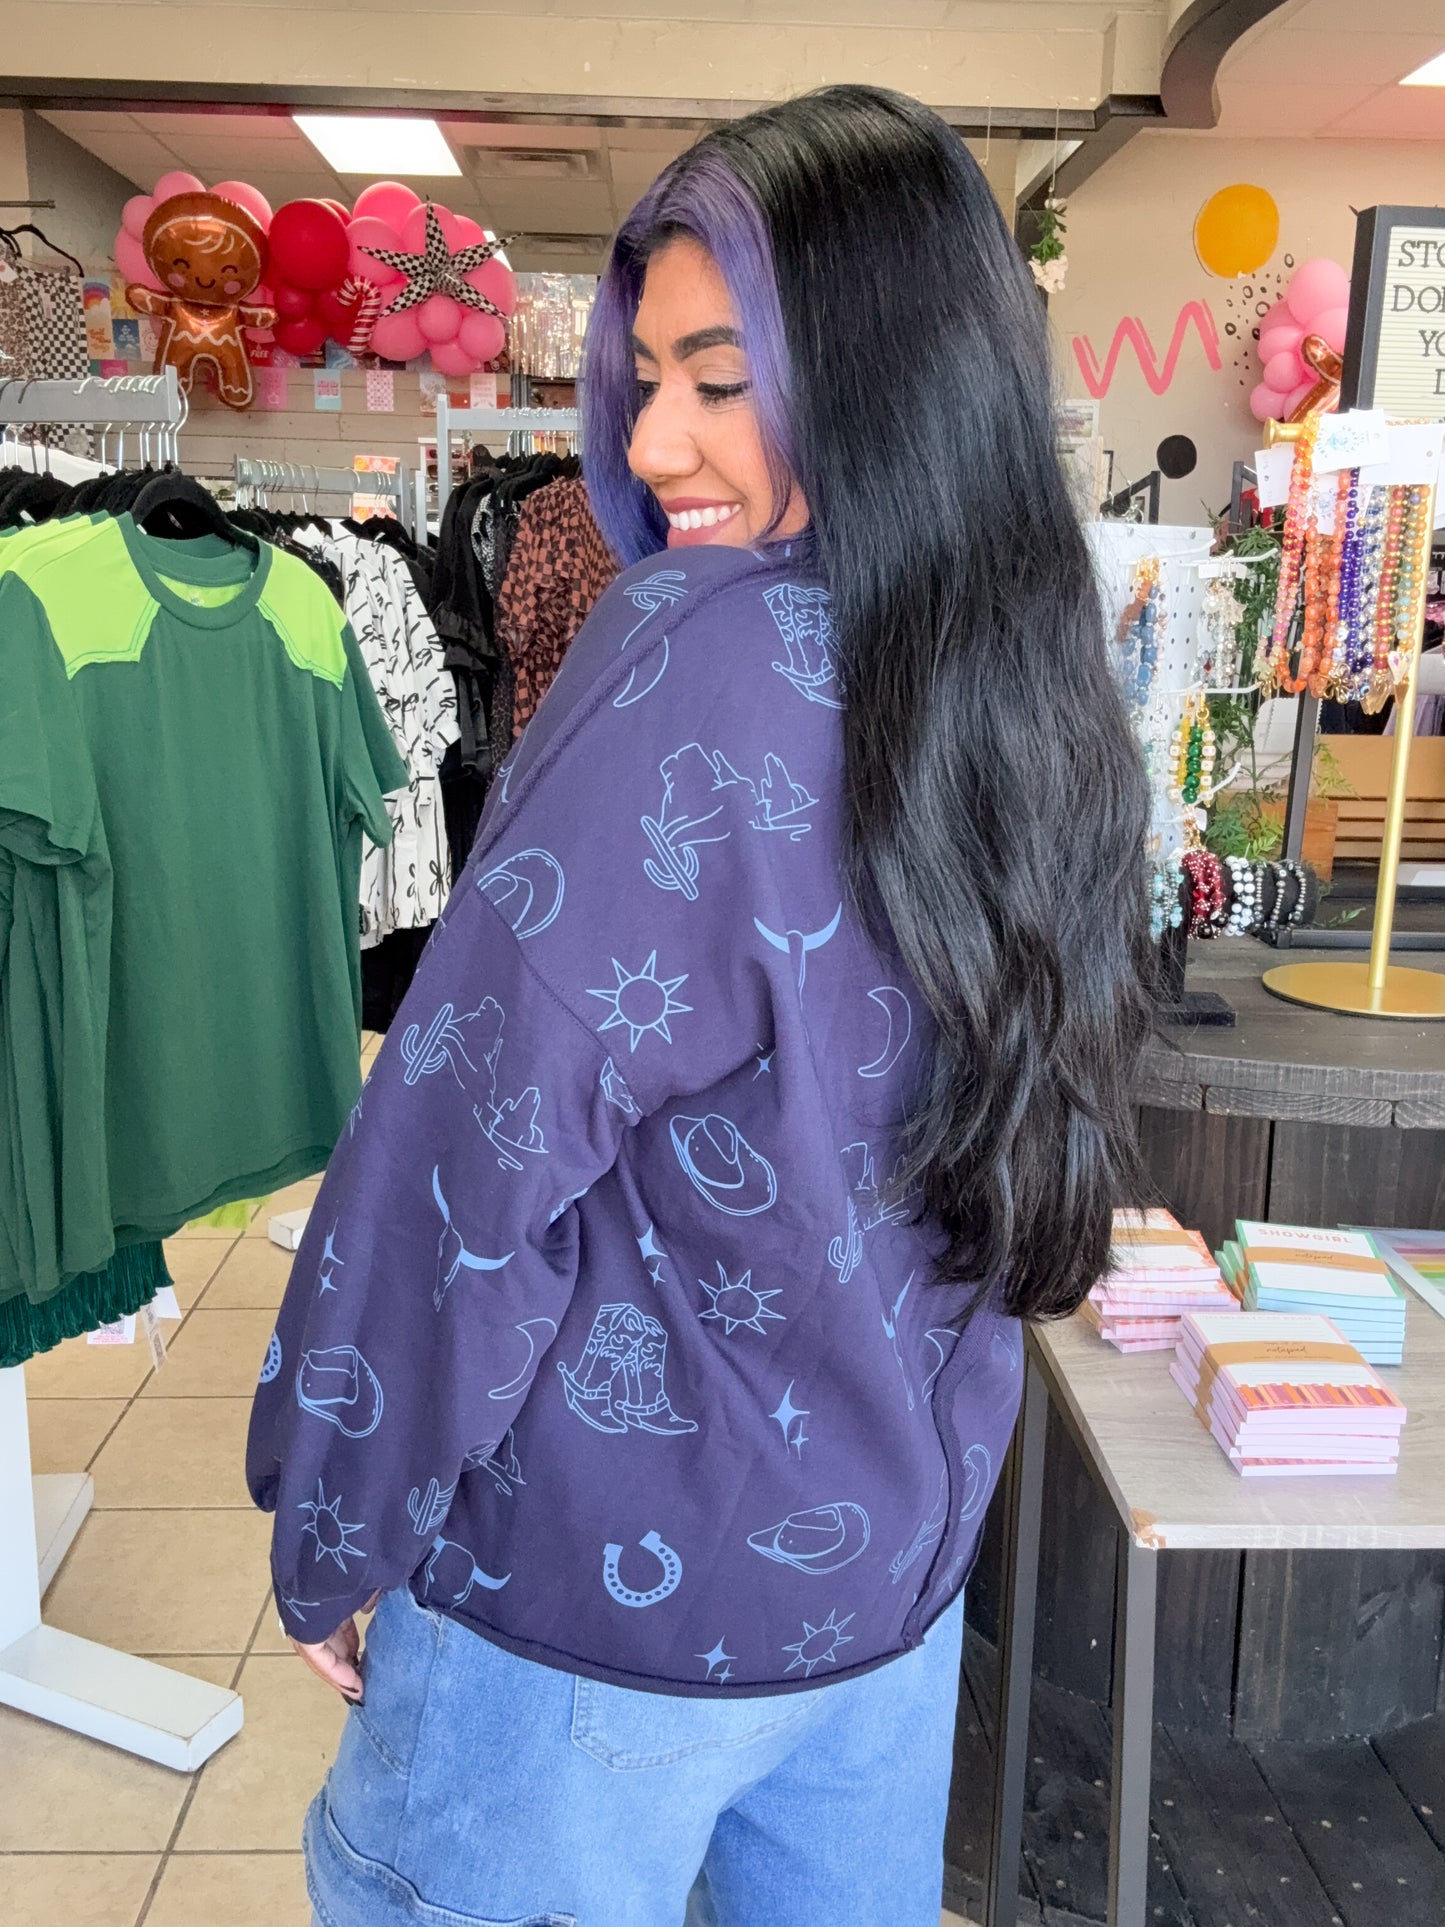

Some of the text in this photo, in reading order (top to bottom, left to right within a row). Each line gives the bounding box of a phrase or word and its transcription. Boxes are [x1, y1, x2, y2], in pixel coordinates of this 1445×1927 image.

[1391, 284, 1445, 313] DO
[1258, 1228, 1352, 1244] SHOWGIRL
[1266, 1345, 1307, 1355] notepad
